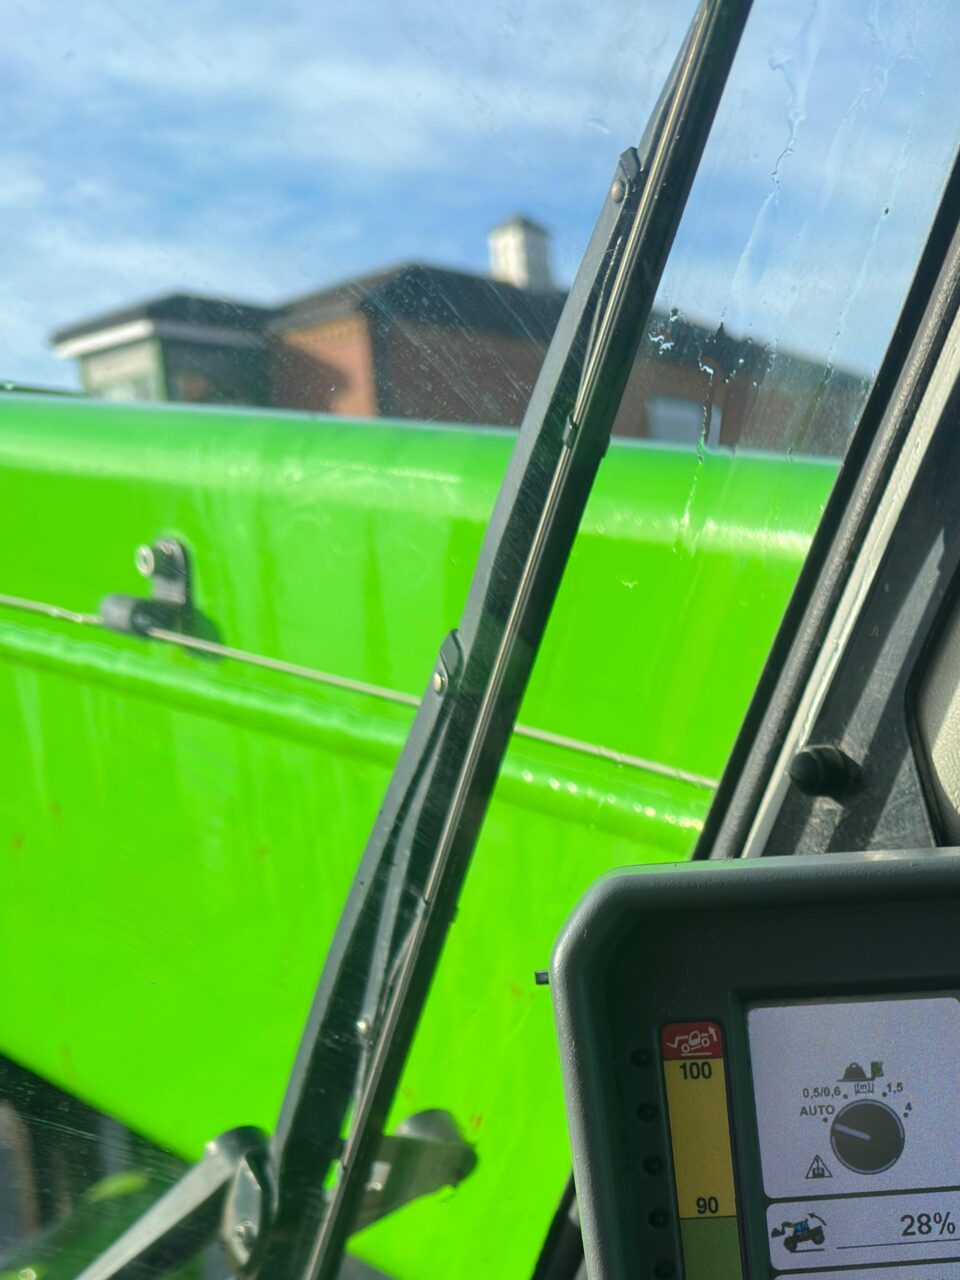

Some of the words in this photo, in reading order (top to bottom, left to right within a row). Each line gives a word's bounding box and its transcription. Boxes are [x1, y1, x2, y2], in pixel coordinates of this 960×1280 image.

[680, 1062, 712, 1080] 100
[802, 1086, 841, 1099] 0,5/0,6
[887, 1082, 904, 1093] 1,5
[800, 1105, 835, 1116] AUTO
[905, 1102, 912, 1111] 4
[696, 1197, 719, 1214] 90
[900, 1211, 956, 1237] 28%
